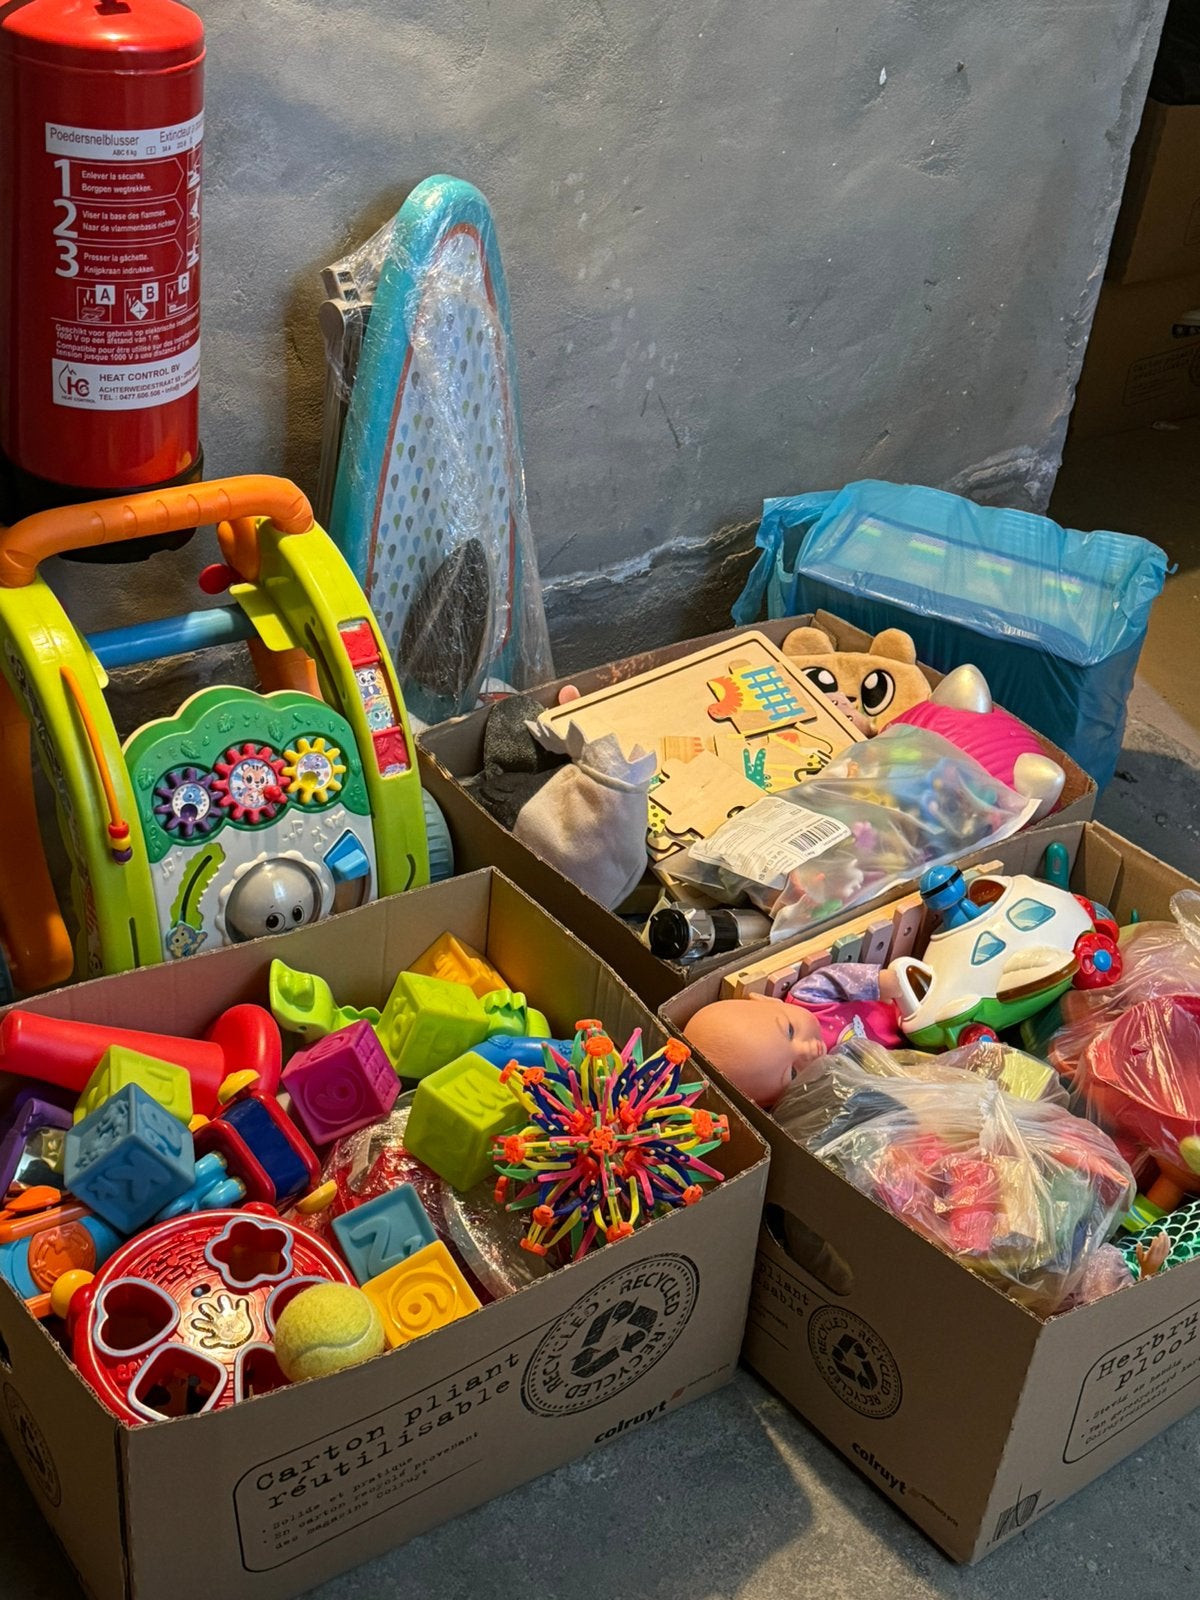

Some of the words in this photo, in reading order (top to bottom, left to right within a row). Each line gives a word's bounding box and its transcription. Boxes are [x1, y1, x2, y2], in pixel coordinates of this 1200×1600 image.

[50, 127, 140, 146] Poedersnelblusser
[54, 159, 71, 197] 1
[82, 170, 108, 180] Enlever
[110, 172, 116, 180] la
[82, 183, 112, 194] Borgpen
[53, 199, 78, 238] 2
[82, 210, 100, 219] Viser
[102, 212, 108, 220] la
[110, 211, 126, 220] base
[127, 212, 139, 220] des
[82, 222, 99, 231] Naar
[100, 224, 109, 232] de
[55, 240, 79, 278] 3
[84, 252, 111, 261] Presser
[112, 254, 118, 262] la
[84, 265, 120, 275] Knijpkraan
[100, 288, 111, 301] A
[146, 286, 155, 299] B
[180, 277, 187, 290] C
[56, 323, 86, 335] Geschikt
[106, 330, 133, 339] gebruik
[134, 330, 144, 338] op
[56, 340, 96, 353] Compatible
[56, 348, 82, 358] tension
[84, 351, 108, 362] jusque
[99, 373, 125, 382] HEAT
[127, 367, 169, 381] CONTROL
[171, 363, 181, 373] BV
[99, 377, 174, 393] ACHTERWEIDESTRAAT
[619, 1271, 681, 1317] RECYCLED
[542, 1301, 600, 1394] RECYCLED
[817, 1316, 849, 1356] RECYCLED
[1096, 1311, 1200, 1381] Herbru
[564, 1330, 667, 1400] RECYCLED
[858, 1330, 892, 1397] RECYCLED
[1114, 1326, 1197, 1392] plooi
[827, 1365, 881, 1406] RECYCLED
[256, 1424, 386, 1491] Carton
[404, 1352, 521, 1427] pliant
[594, 1400, 667, 1444] colruyt
[268, 1377, 512, 1510] réutilisable
[414, 1431, 479, 1470] provenant
[352, 1457, 413, 1492] pratique
[851, 1441, 907, 1495] colruyt
